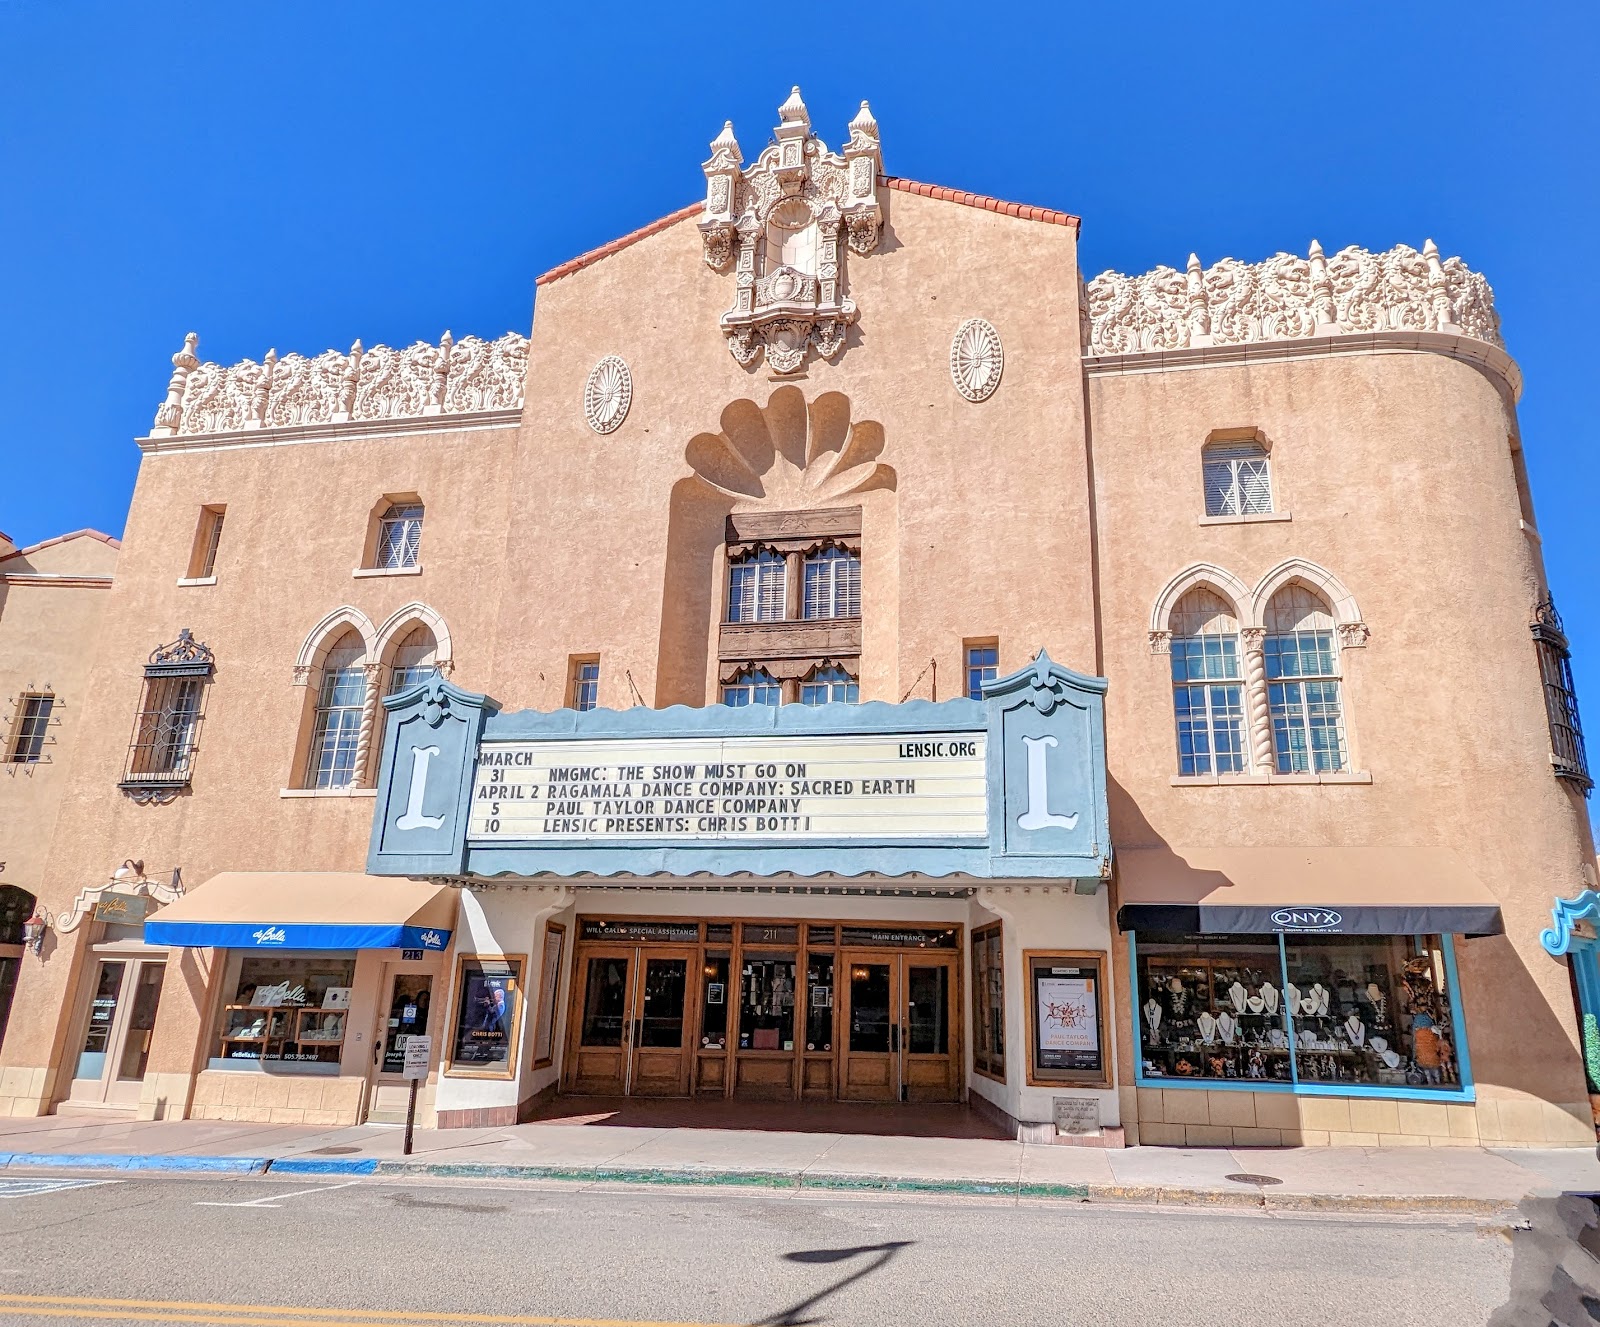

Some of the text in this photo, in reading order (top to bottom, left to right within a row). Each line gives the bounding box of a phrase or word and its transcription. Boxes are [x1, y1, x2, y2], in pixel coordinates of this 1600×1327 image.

[900, 742, 976, 757] LENSIC.ORG
[482, 752, 533, 765] MARCH
[491, 769, 505, 782] 31
[549, 763, 806, 781] NMGMC: THE SHOW MUST GO ON
[478, 779, 915, 799] APRIL 2 RAGAMALA DANCE COMPANY: SACRED EARTH
[491, 802, 500, 815] 5
[546, 798, 801, 815] PAUL TAYLOR DANCE COMPANY
[485, 819, 500, 832] 10
[543, 818, 598, 832] LENSIC
[605, 817, 690, 832] PRESENTS:
[697, 816, 747, 831] CHRIS
[1274, 912, 1336, 923] ONYX
[657, 928, 698, 936] ASSISTANCE
[763, 929, 778, 940] 211
[871, 933, 926, 942] MAIN ENTRANCE
[404, 950, 422, 960] 213
